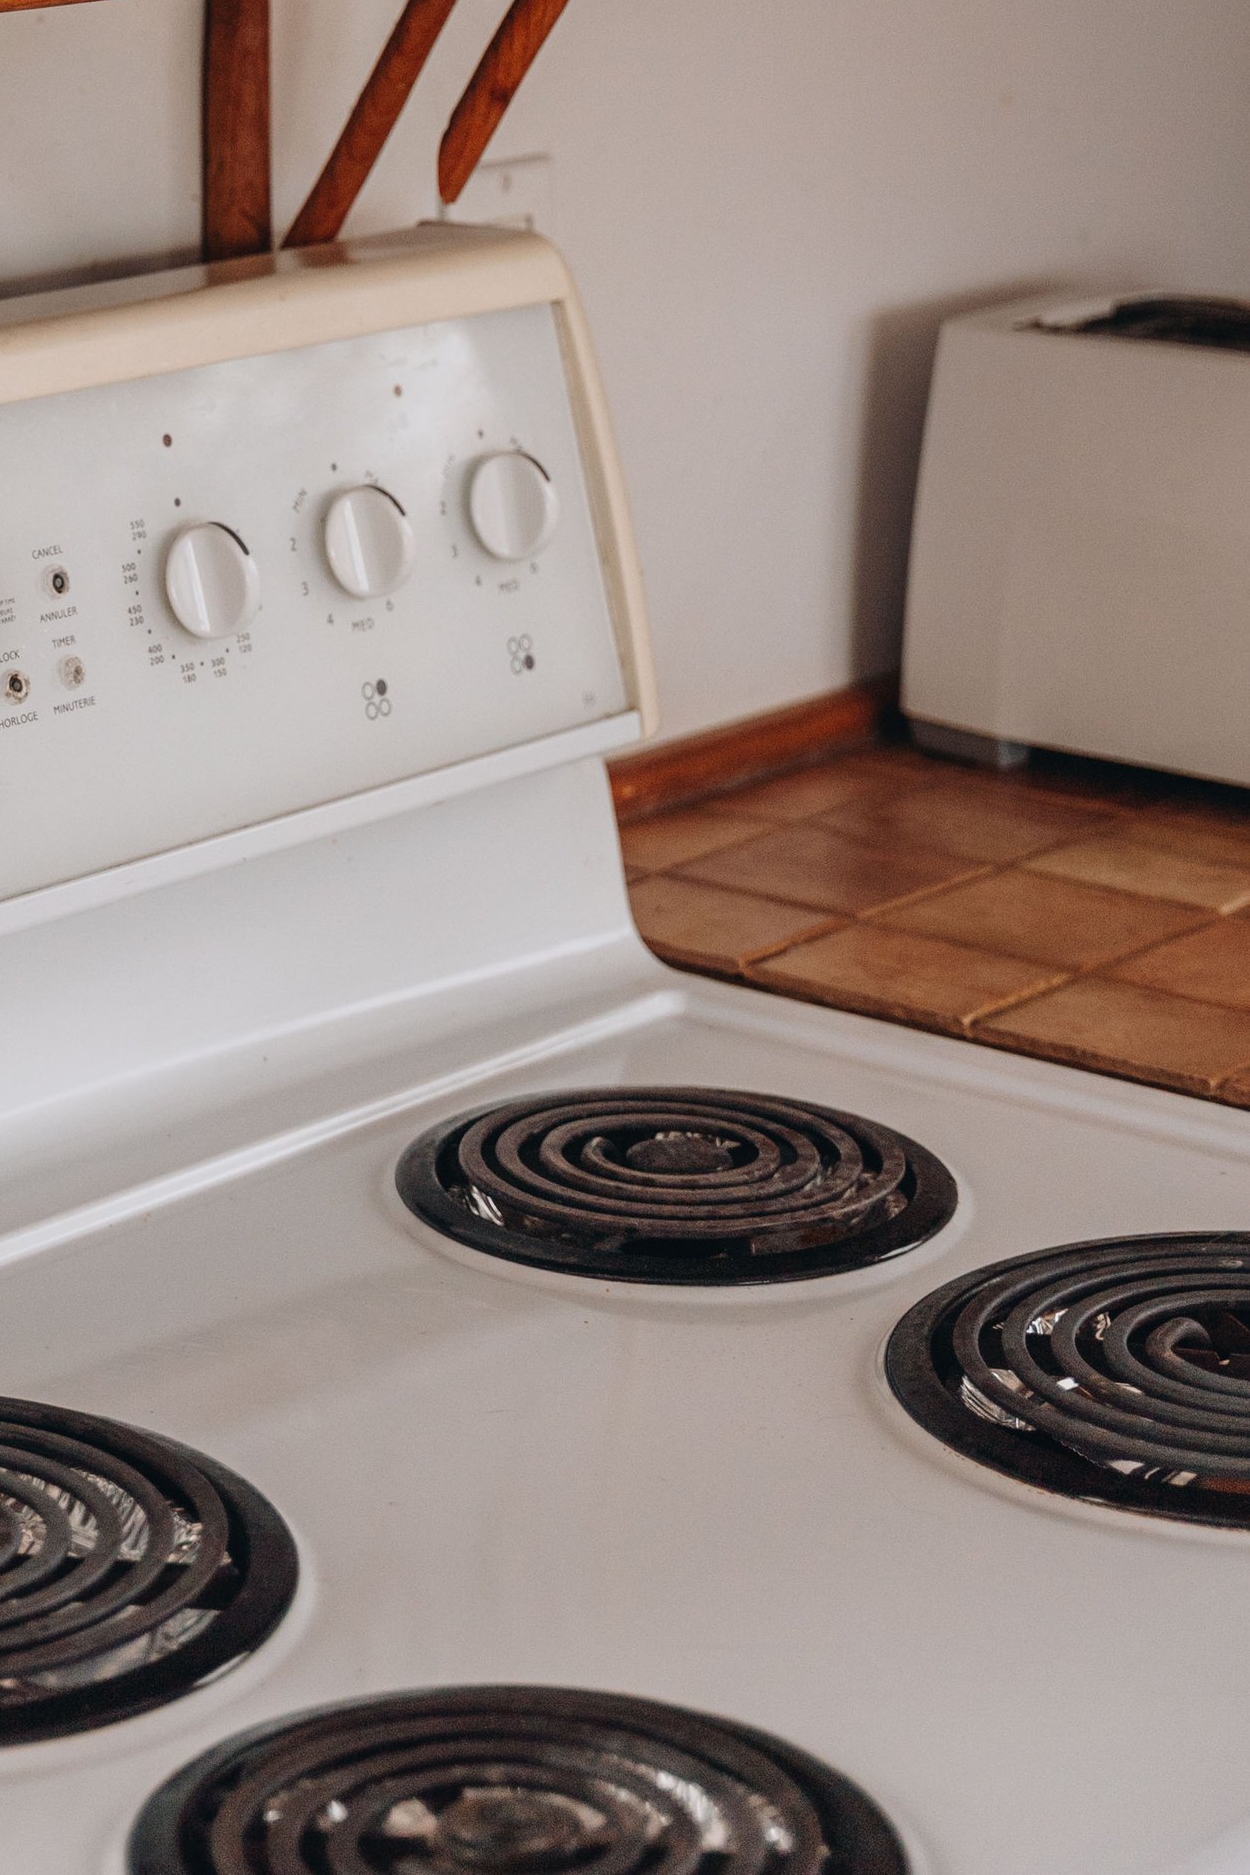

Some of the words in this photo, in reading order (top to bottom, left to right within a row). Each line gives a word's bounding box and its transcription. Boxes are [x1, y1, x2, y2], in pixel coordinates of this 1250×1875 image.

[31, 545, 63, 560] CANCEL
[121, 562, 137, 573] 500
[40, 606, 78, 623] ANNULER
[127, 604, 142, 614] 450
[52, 635, 77, 649] TIMER
[148, 644, 163, 654] 400
[150, 655, 165, 666] 200
[180, 662, 195, 673] 350
[53, 695, 97, 715] MINUTERIE
